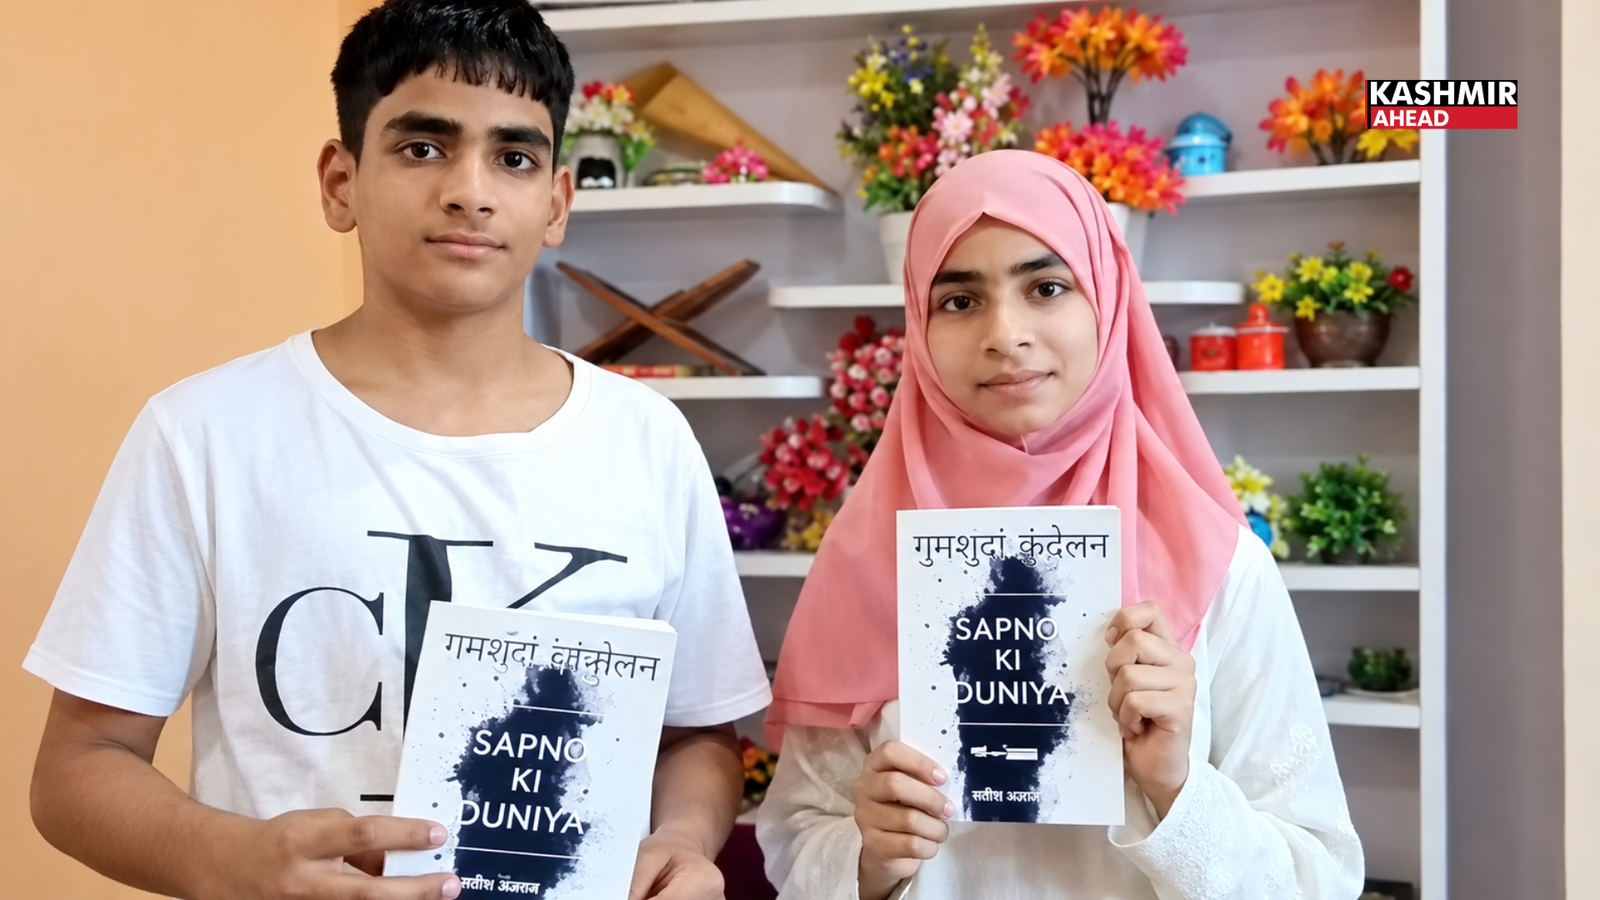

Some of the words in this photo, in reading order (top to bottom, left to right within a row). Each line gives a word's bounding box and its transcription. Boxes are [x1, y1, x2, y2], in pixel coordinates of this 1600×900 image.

[955, 617, 1058, 641] SAPNO
[995, 649, 1020, 670] KI
[955, 681, 1070, 705] DUNIYA
[473, 729, 588, 763] SAPNO
[511, 767, 541, 793] KI
[971, 787, 1003, 802] सतीश
[458, 799, 584, 834] DUNIYA
[460, 873, 495, 892] सतीश
